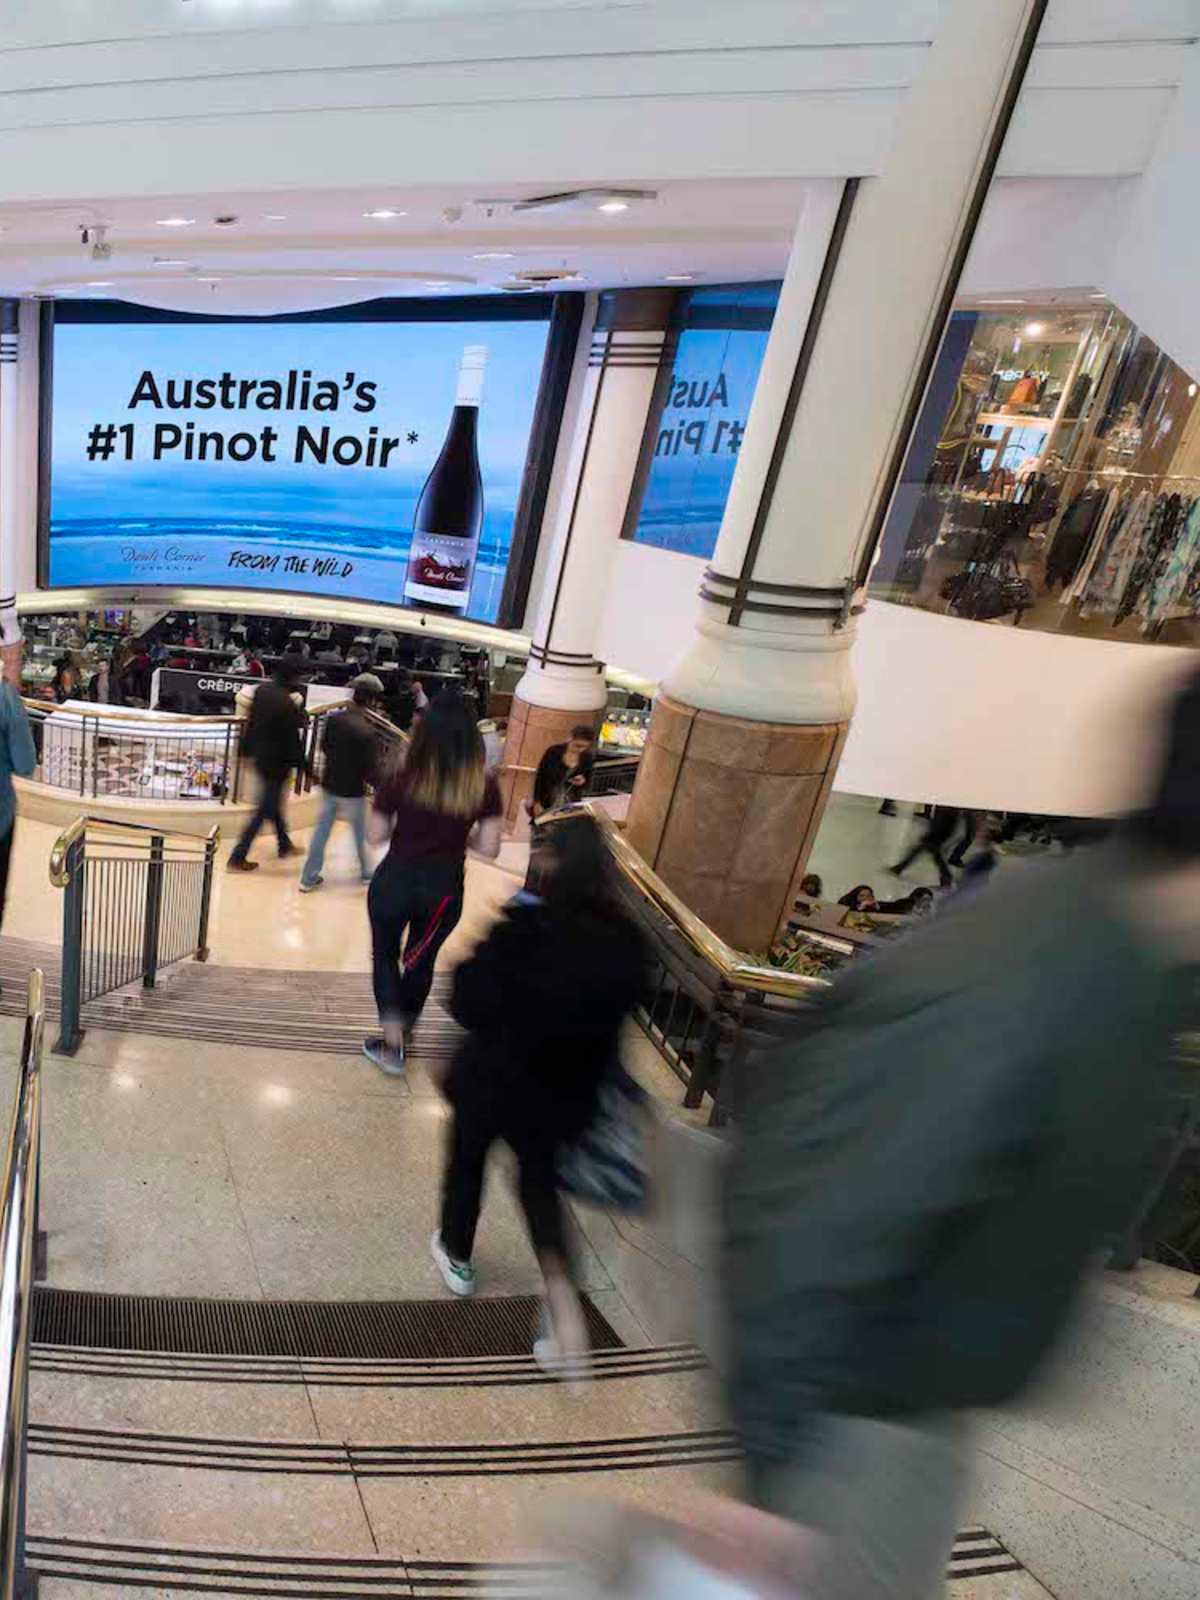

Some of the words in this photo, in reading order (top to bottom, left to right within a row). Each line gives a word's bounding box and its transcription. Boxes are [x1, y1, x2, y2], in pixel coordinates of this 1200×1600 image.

[127, 370, 378, 413] Australia's
[86, 423, 134, 461] #1
[153, 422, 277, 462] Pinot
[227, 550, 280, 573] FROM
[284, 556, 309, 575] THE
[197, 678, 246, 692] CRÊPE
